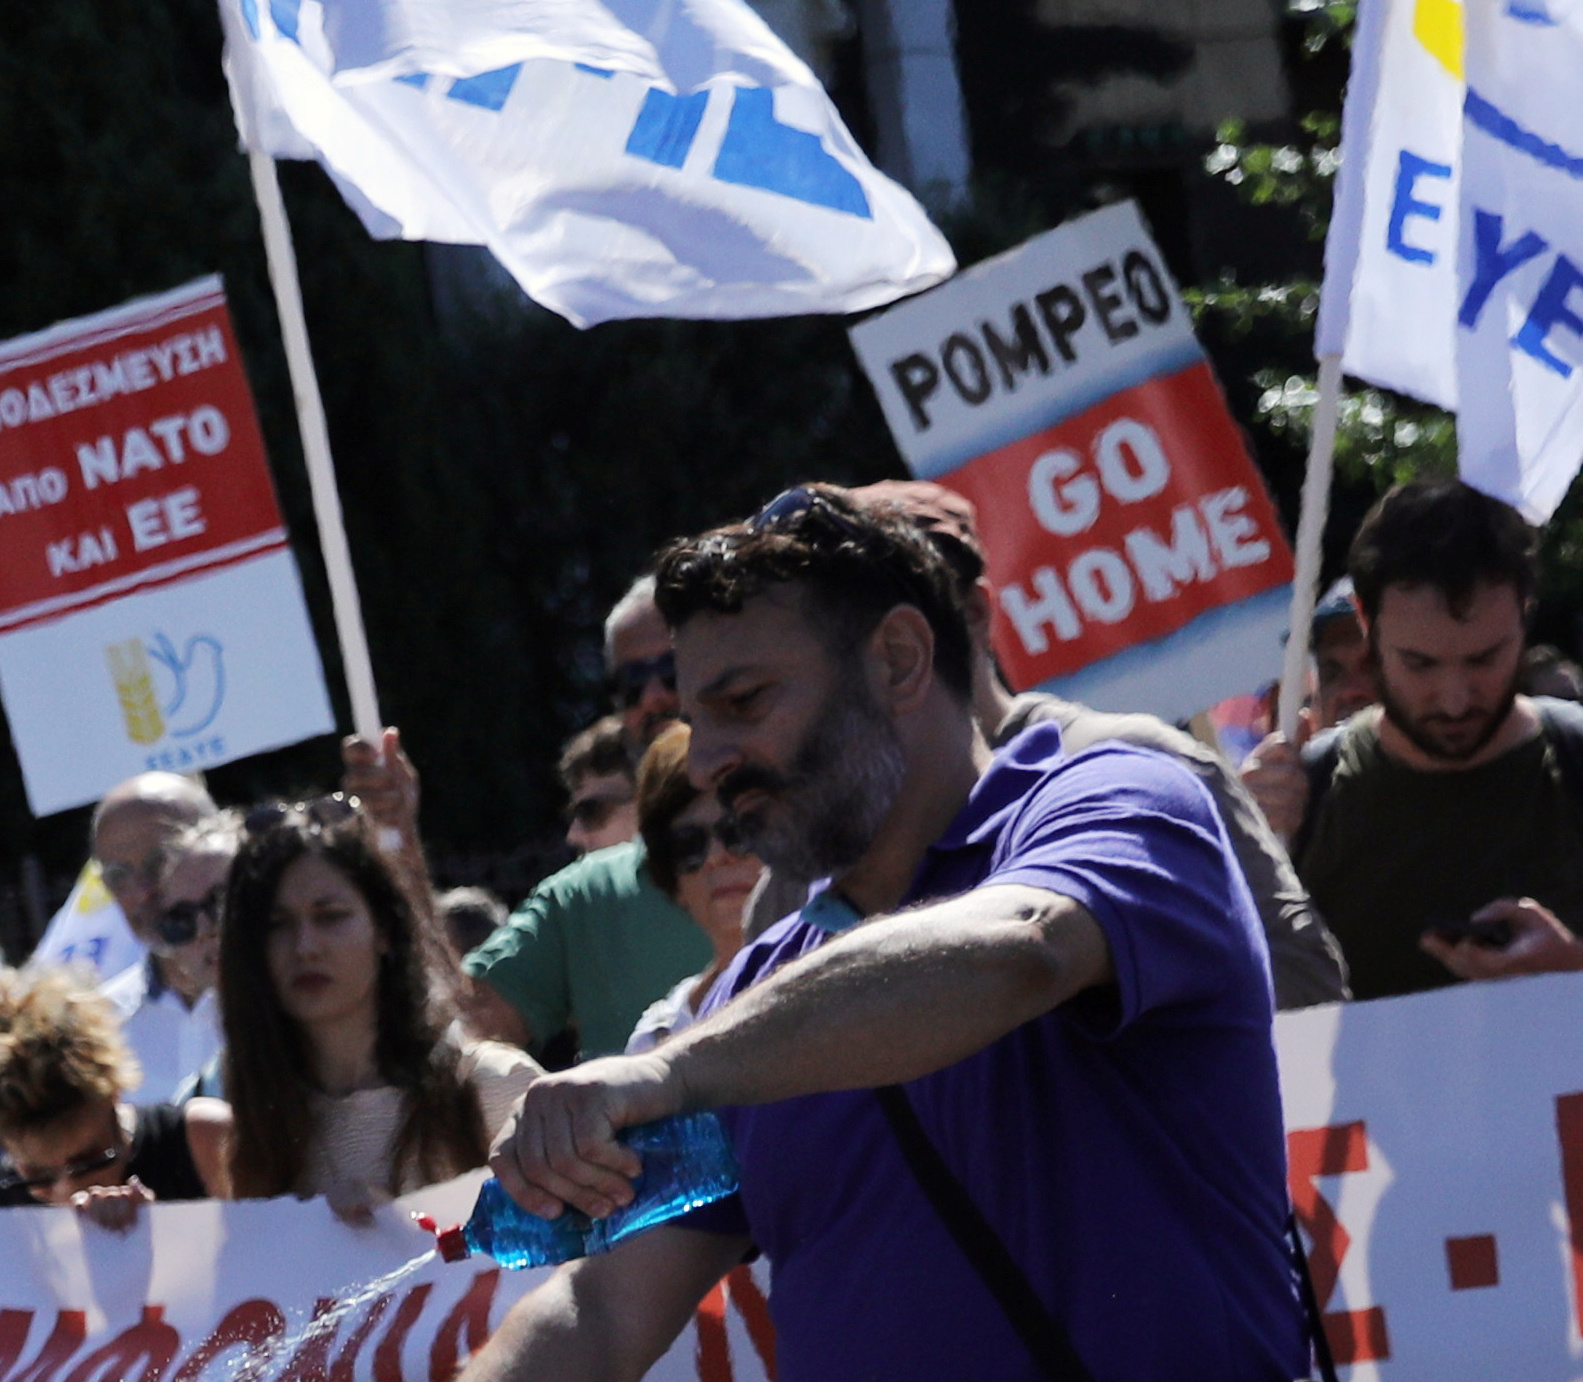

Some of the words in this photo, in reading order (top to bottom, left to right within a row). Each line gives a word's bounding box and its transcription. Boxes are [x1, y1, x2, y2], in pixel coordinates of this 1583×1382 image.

[889, 250, 1172, 431] POMPEO
[76, 404, 231, 490] ΝΑΤΟ
[1028, 416, 1172, 537] GO
[45, 526, 118, 577] ΚΑΙ
[127, 486, 207, 552] ΕΕ
[999, 485, 1272, 656] HOME
